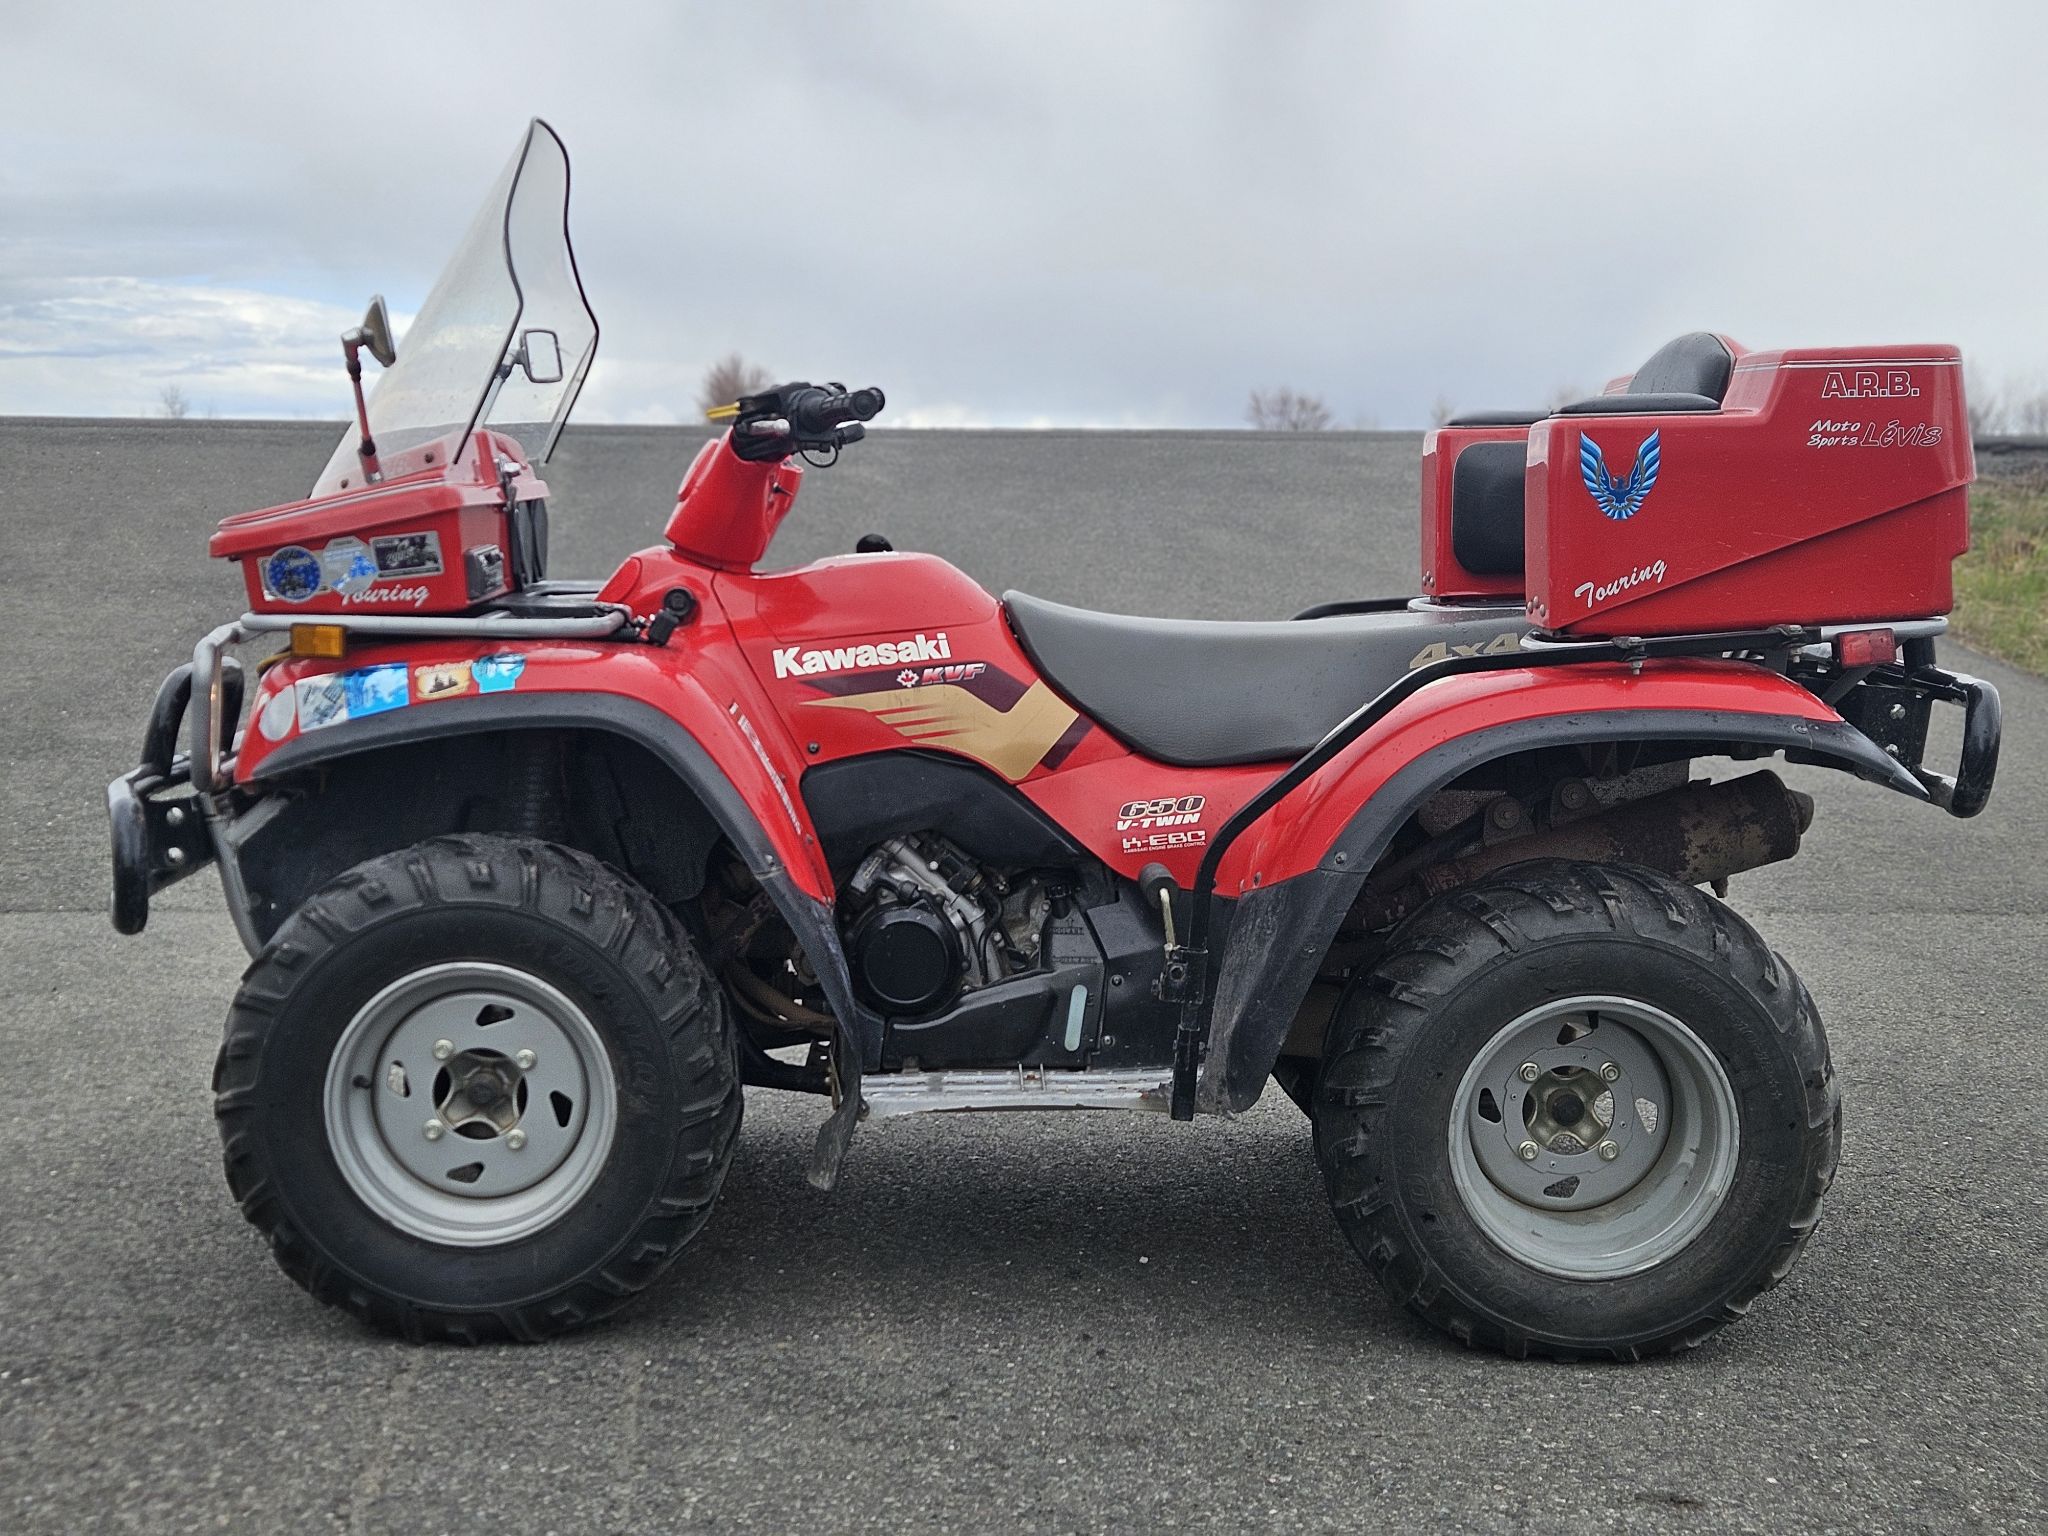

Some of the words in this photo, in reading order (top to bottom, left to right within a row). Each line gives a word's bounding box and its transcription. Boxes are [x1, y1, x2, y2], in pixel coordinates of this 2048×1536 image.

[1821, 370, 1920, 398] A.R.B.
[1808, 419, 1861, 433] Moto
[1860, 419, 1943, 448] Lévis
[1806, 433, 1859, 449] Sports
[1574, 558, 1668, 609] Touring
[771, 632, 952, 680] Kawasaki
[1409, 632, 1522, 670] 4x4
[920, 662, 988, 686] KVF
[1118, 795, 1206, 819] 650
[1116, 812, 1202, 831] V-TWIN
[1122, 830, 1207, 849] K-EBC
